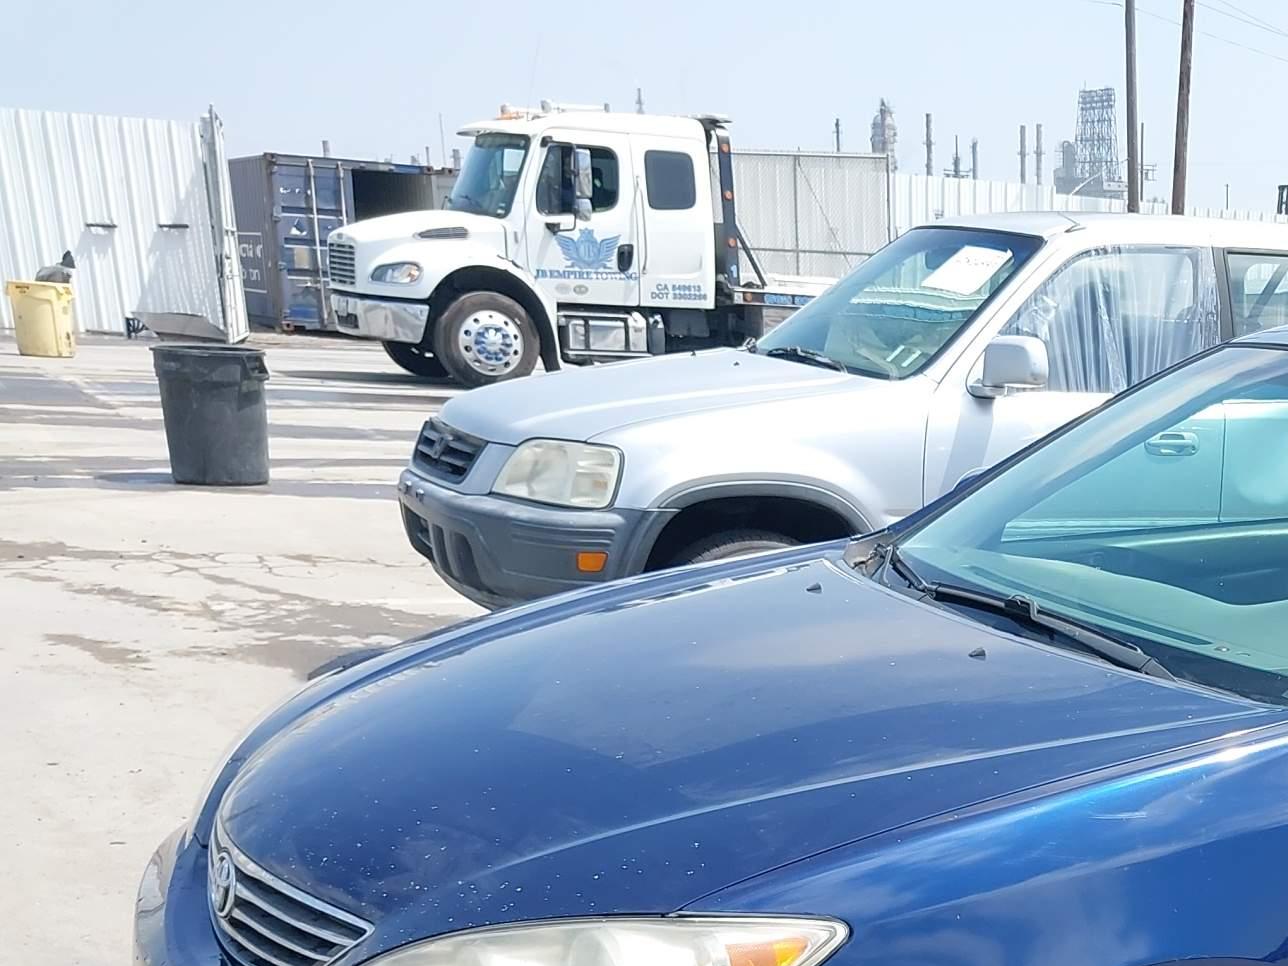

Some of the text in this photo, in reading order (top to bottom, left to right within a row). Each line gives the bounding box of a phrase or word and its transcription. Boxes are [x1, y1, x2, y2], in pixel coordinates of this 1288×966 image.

[534, 269, 639, 281] JB EMPIRE TOWING
[656, 283, 669, 292] CA
[650, 291, 669, 300] DOT
